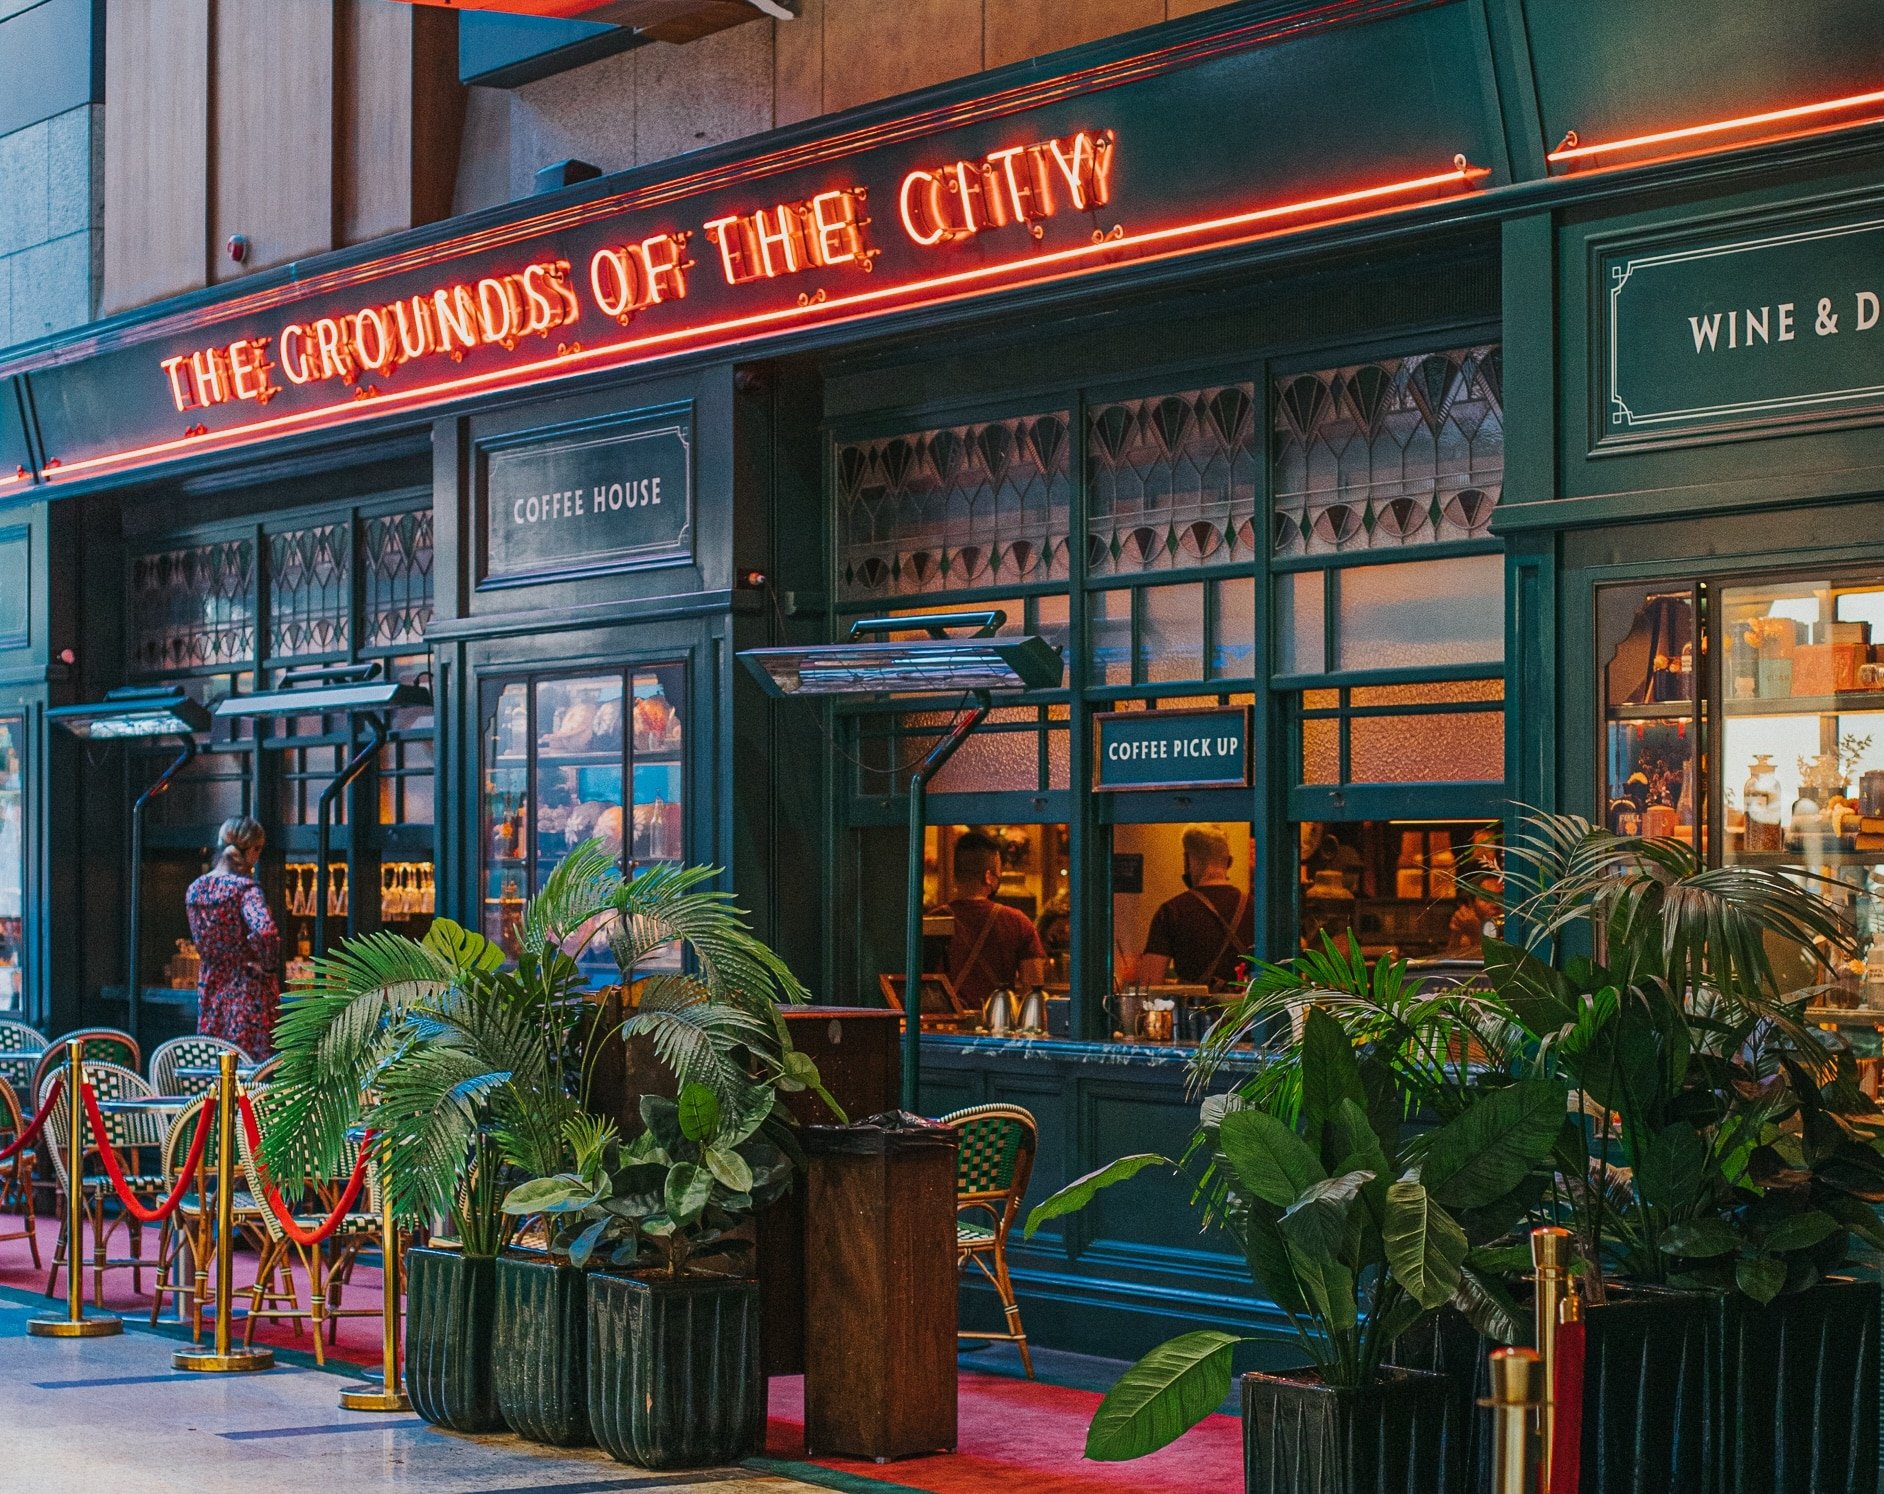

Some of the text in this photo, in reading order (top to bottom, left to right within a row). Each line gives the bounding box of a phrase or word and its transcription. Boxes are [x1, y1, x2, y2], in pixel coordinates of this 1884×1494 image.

[160, 132, 1086, 412] THE GROUNDS OF THE CITY
[1687, 302, 1796, 355] WINE
[1814, 297, 1840, 337] &
[513, 476, 662, 525] COFFEE HOUSE
[1107, 736, 1239, 761] COFFEE PICK UP
